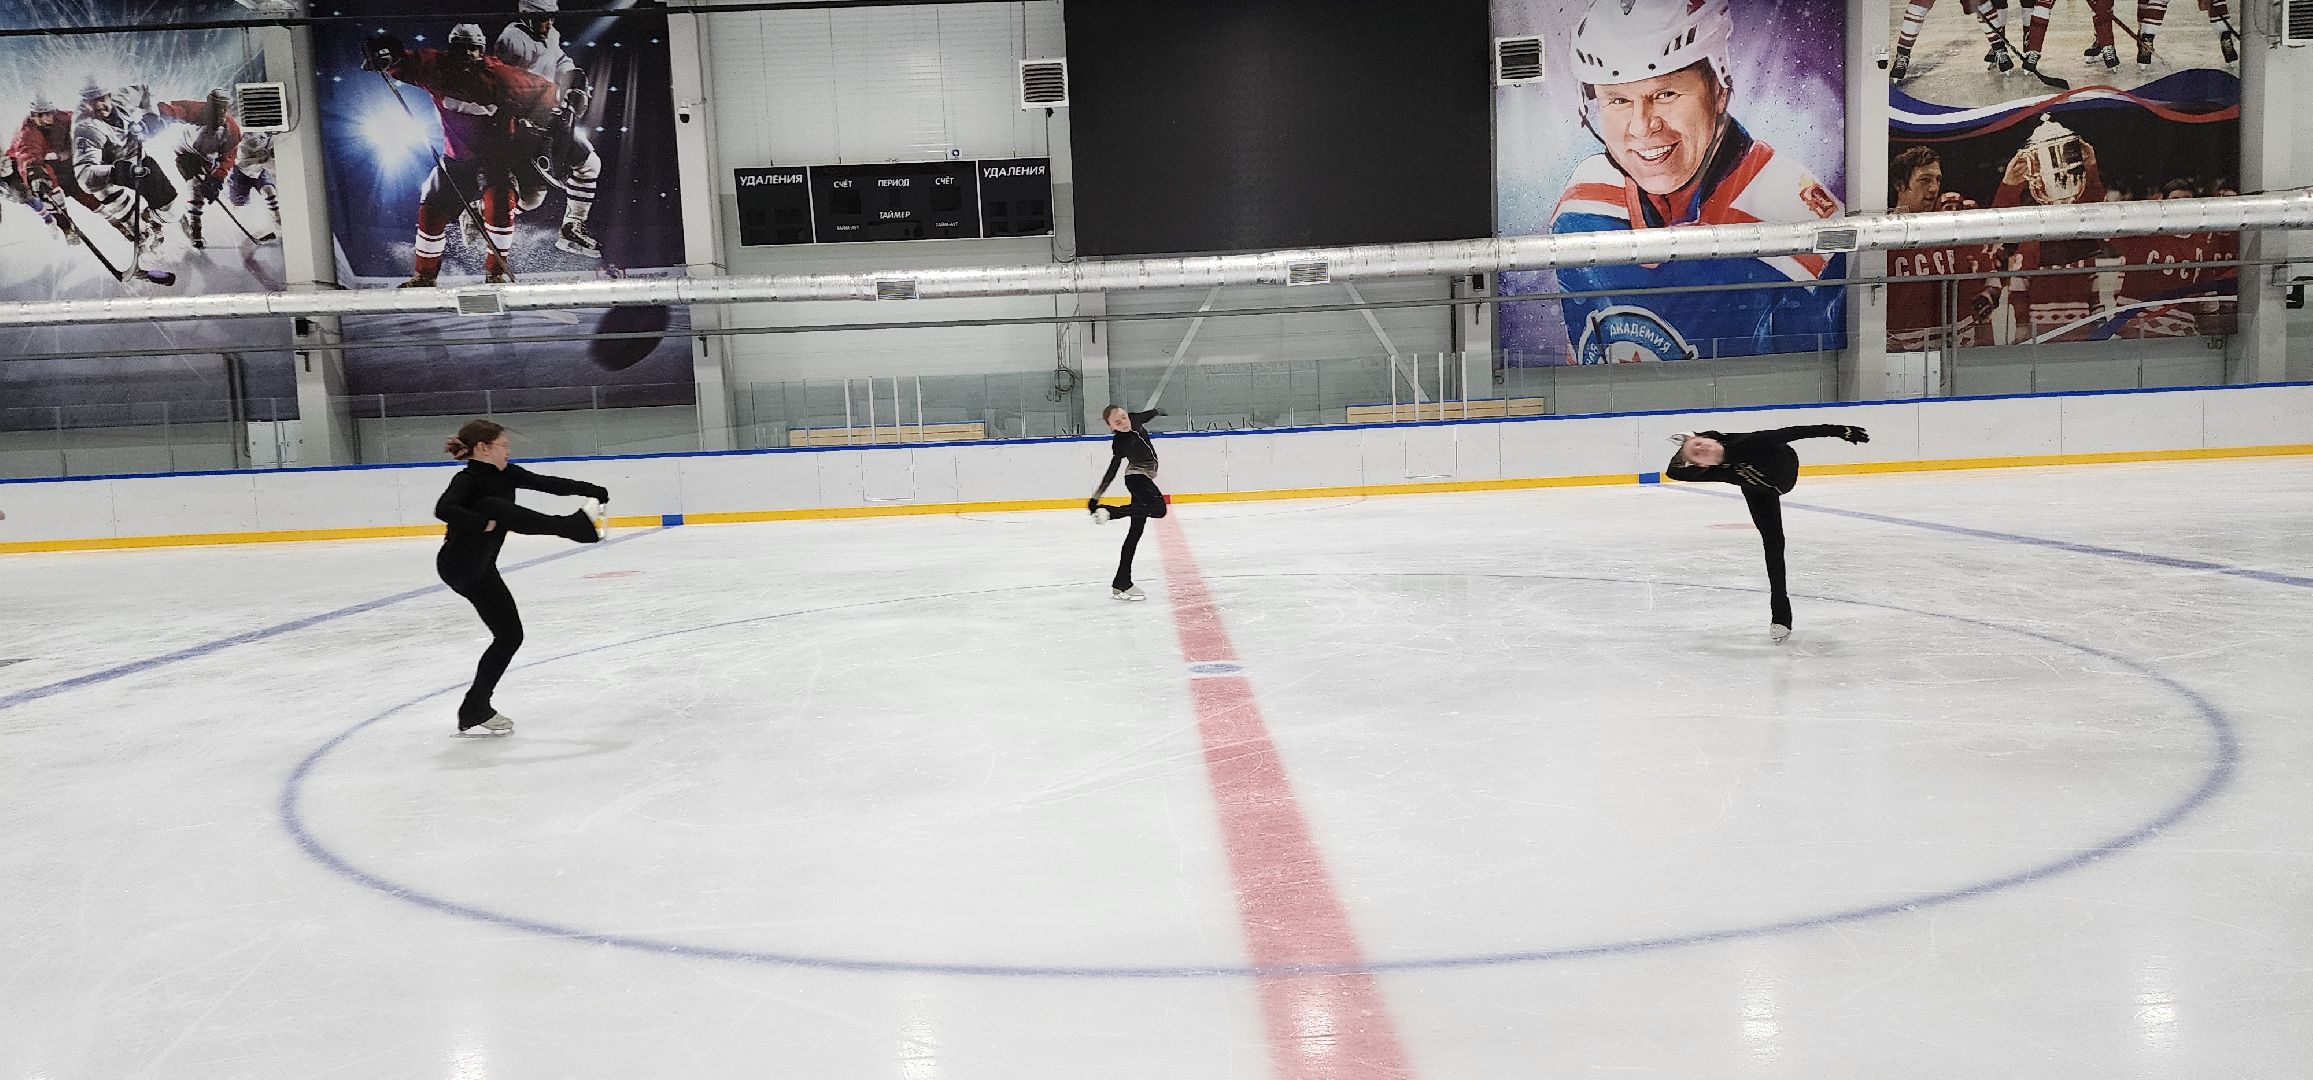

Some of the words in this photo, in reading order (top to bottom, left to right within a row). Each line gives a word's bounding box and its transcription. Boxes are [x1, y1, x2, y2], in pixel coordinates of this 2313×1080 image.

[983, 166, 1046, 179] УДАЛЕНИЯ
[740, 174, 803, 187] УДАЛЕНИЯ
[877, 178, 910, 187] ПЕРИОД
[879, 211, 911, 219] ТАЙМЕР
[1609, 322, 1672, 354] АКАДЕМИЯ
